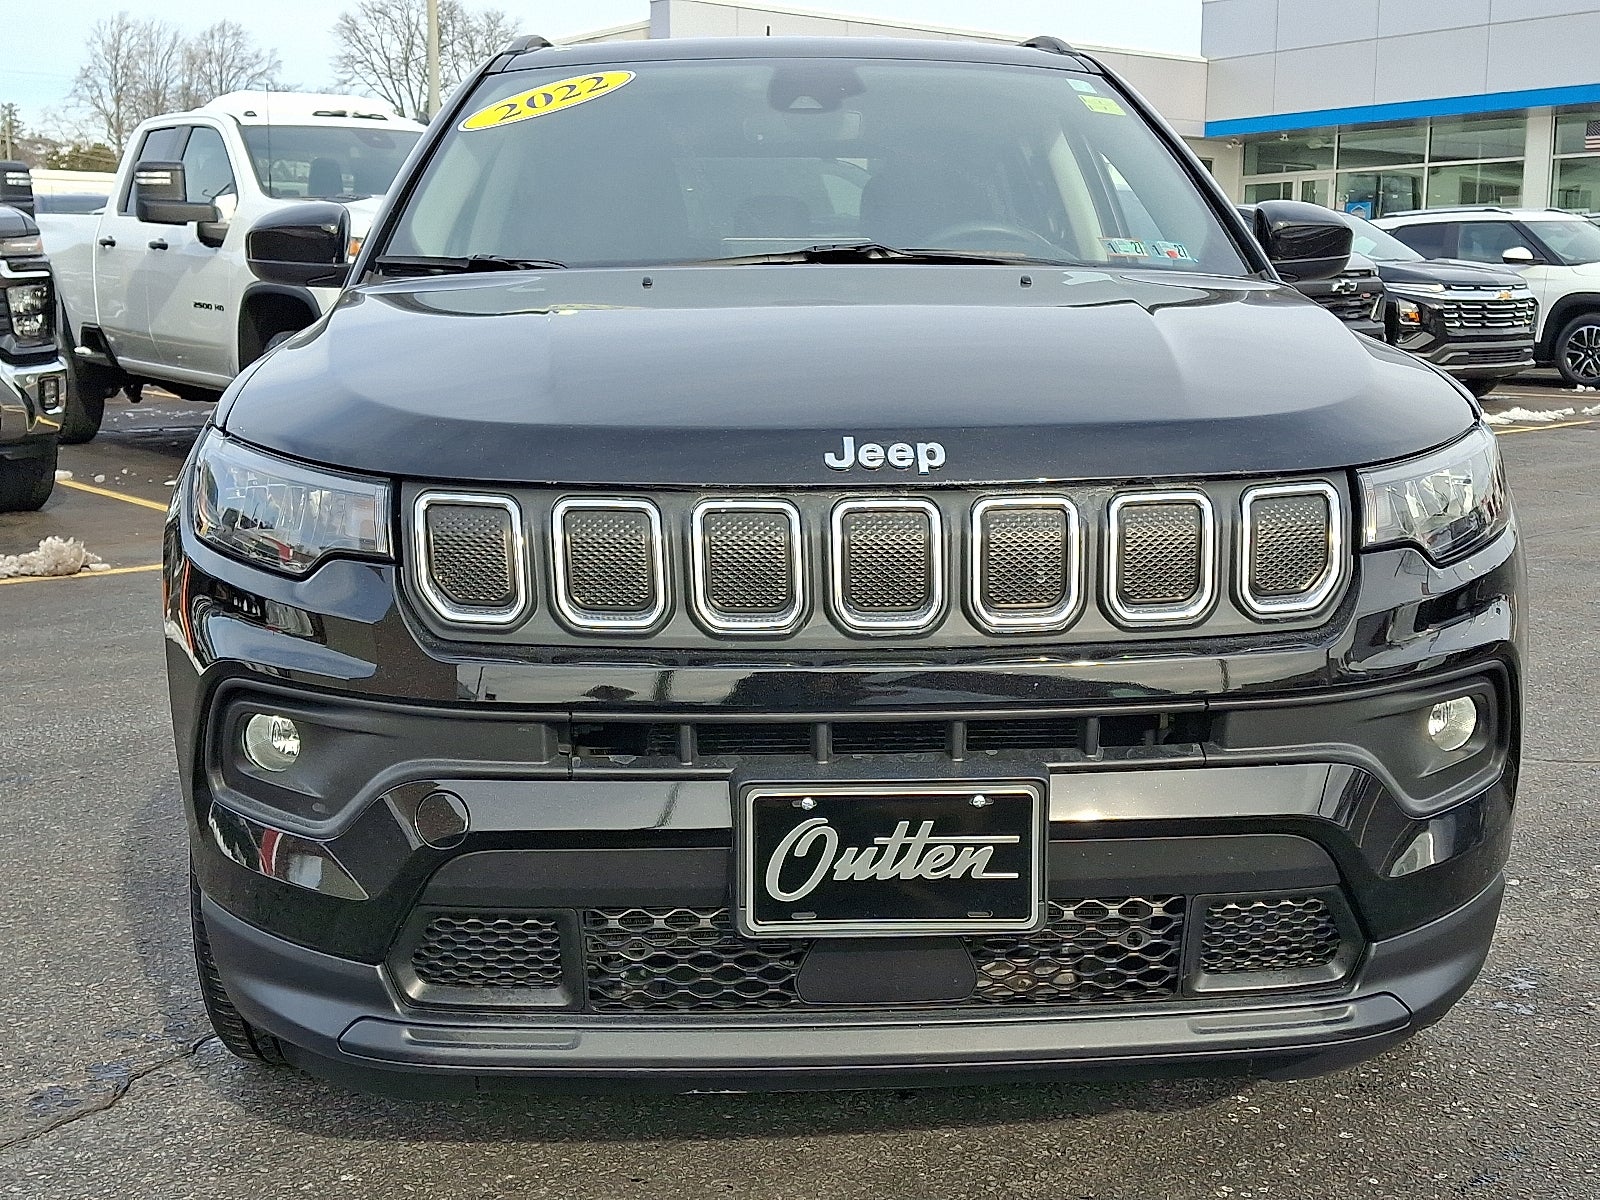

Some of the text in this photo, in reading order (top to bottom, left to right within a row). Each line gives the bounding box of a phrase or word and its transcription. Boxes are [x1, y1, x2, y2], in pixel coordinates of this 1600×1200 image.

[494, 76, 609, 121] 2022
[193, 302, 213, 310] 2500
[824, 436, 946, 475] Jeep
[766, 818, 1020, 901] Outten
